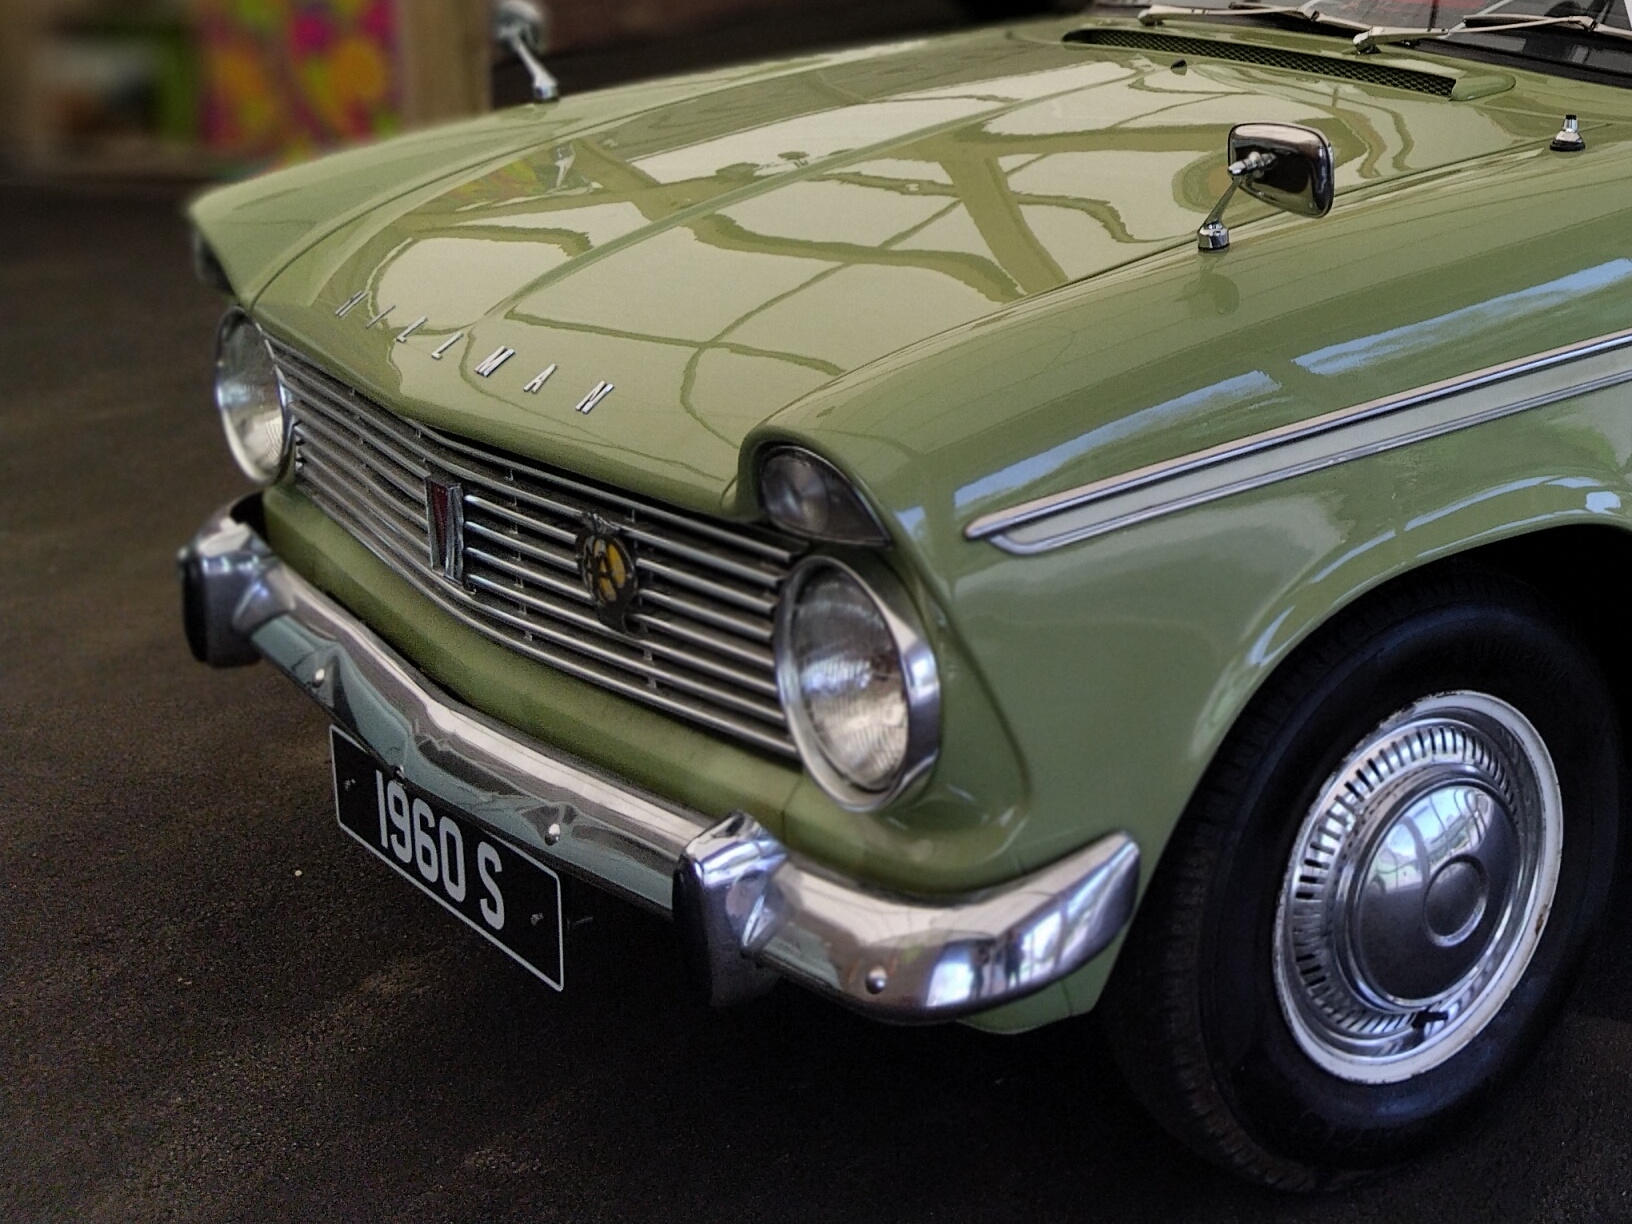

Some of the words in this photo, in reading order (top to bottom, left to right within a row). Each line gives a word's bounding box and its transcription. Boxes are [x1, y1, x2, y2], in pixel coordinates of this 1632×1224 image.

[334, 289, 615, 415] HILLMAN
[375, 769, 466, 903] 1960
[477, 840, 505, 931] S
